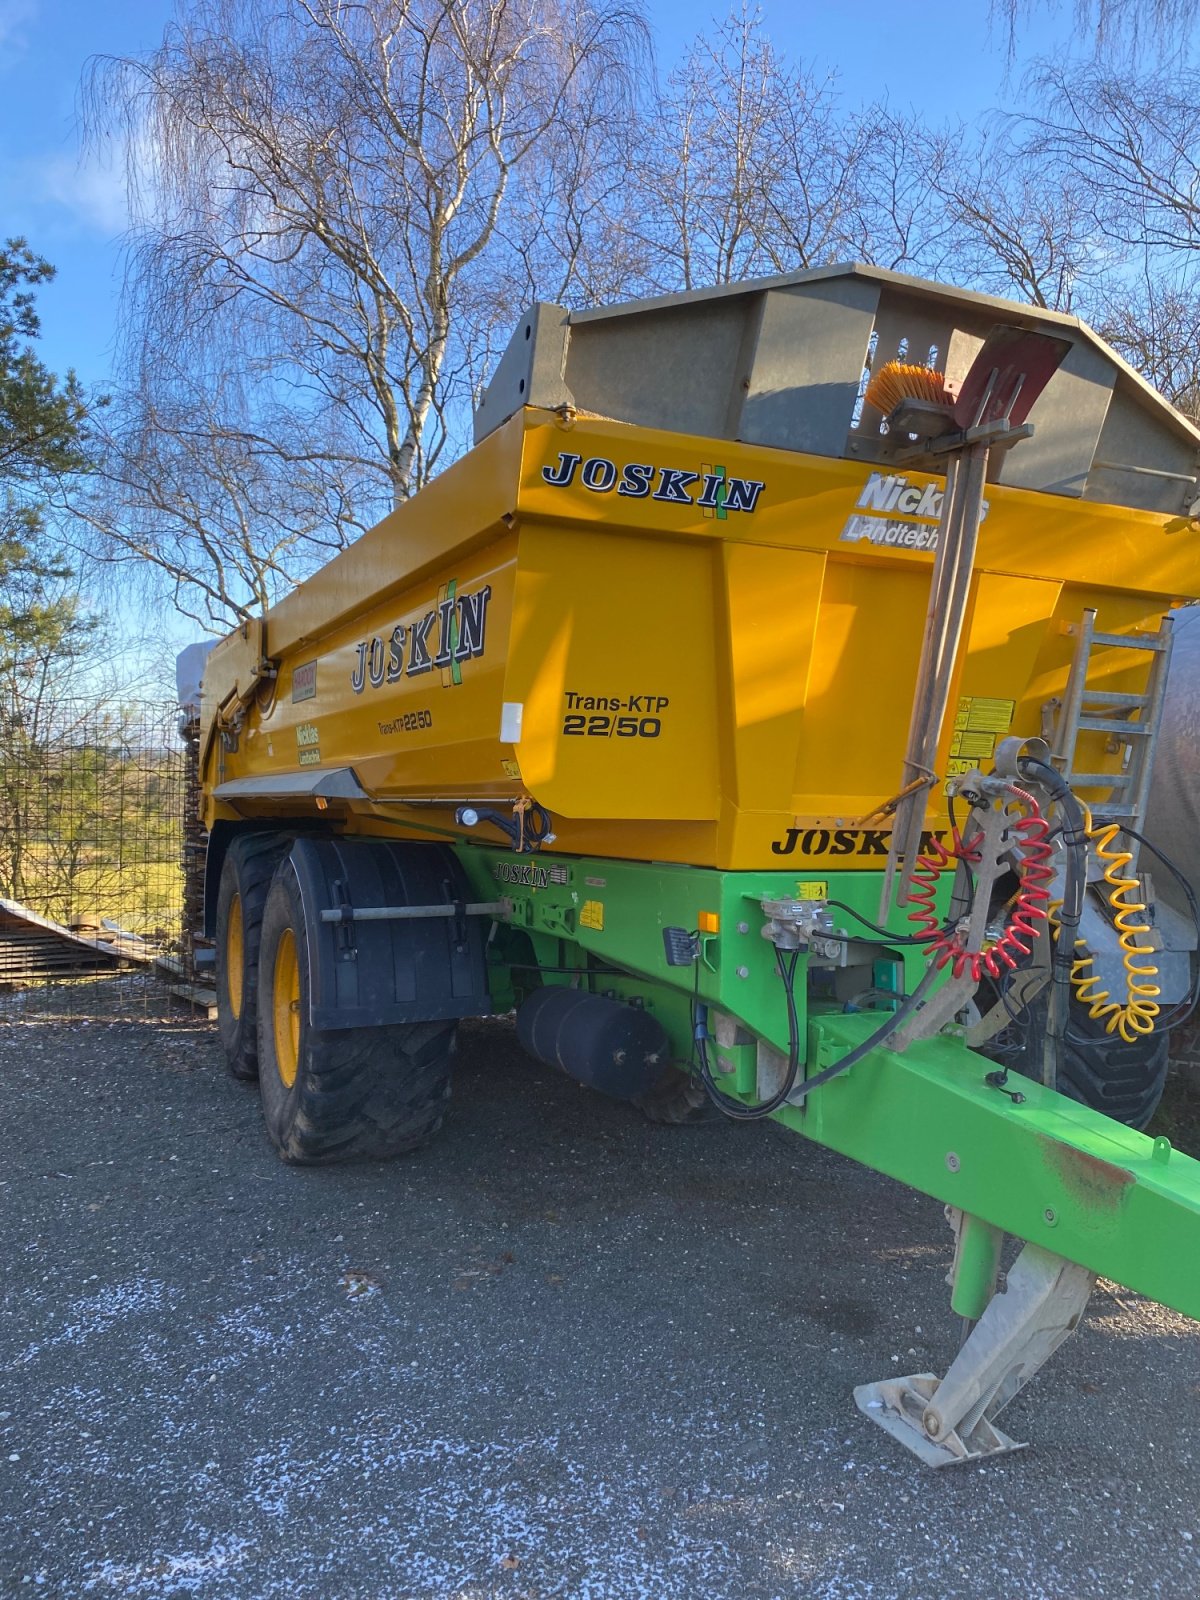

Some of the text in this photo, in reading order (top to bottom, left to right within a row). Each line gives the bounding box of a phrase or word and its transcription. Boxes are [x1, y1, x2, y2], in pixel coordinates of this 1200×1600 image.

[542, 452, 766, 513] JOSKIN
[856, 472, 990, 524] Nicks
[351, 584, 492, 695] JOSKIN
[565, 692, 669, 713] Trans-KTP
[563, 715, 661, 738] 22/50
[771, 829, 947, 859] JOSKN
[495, 862, 550, 889] JOSKIN
